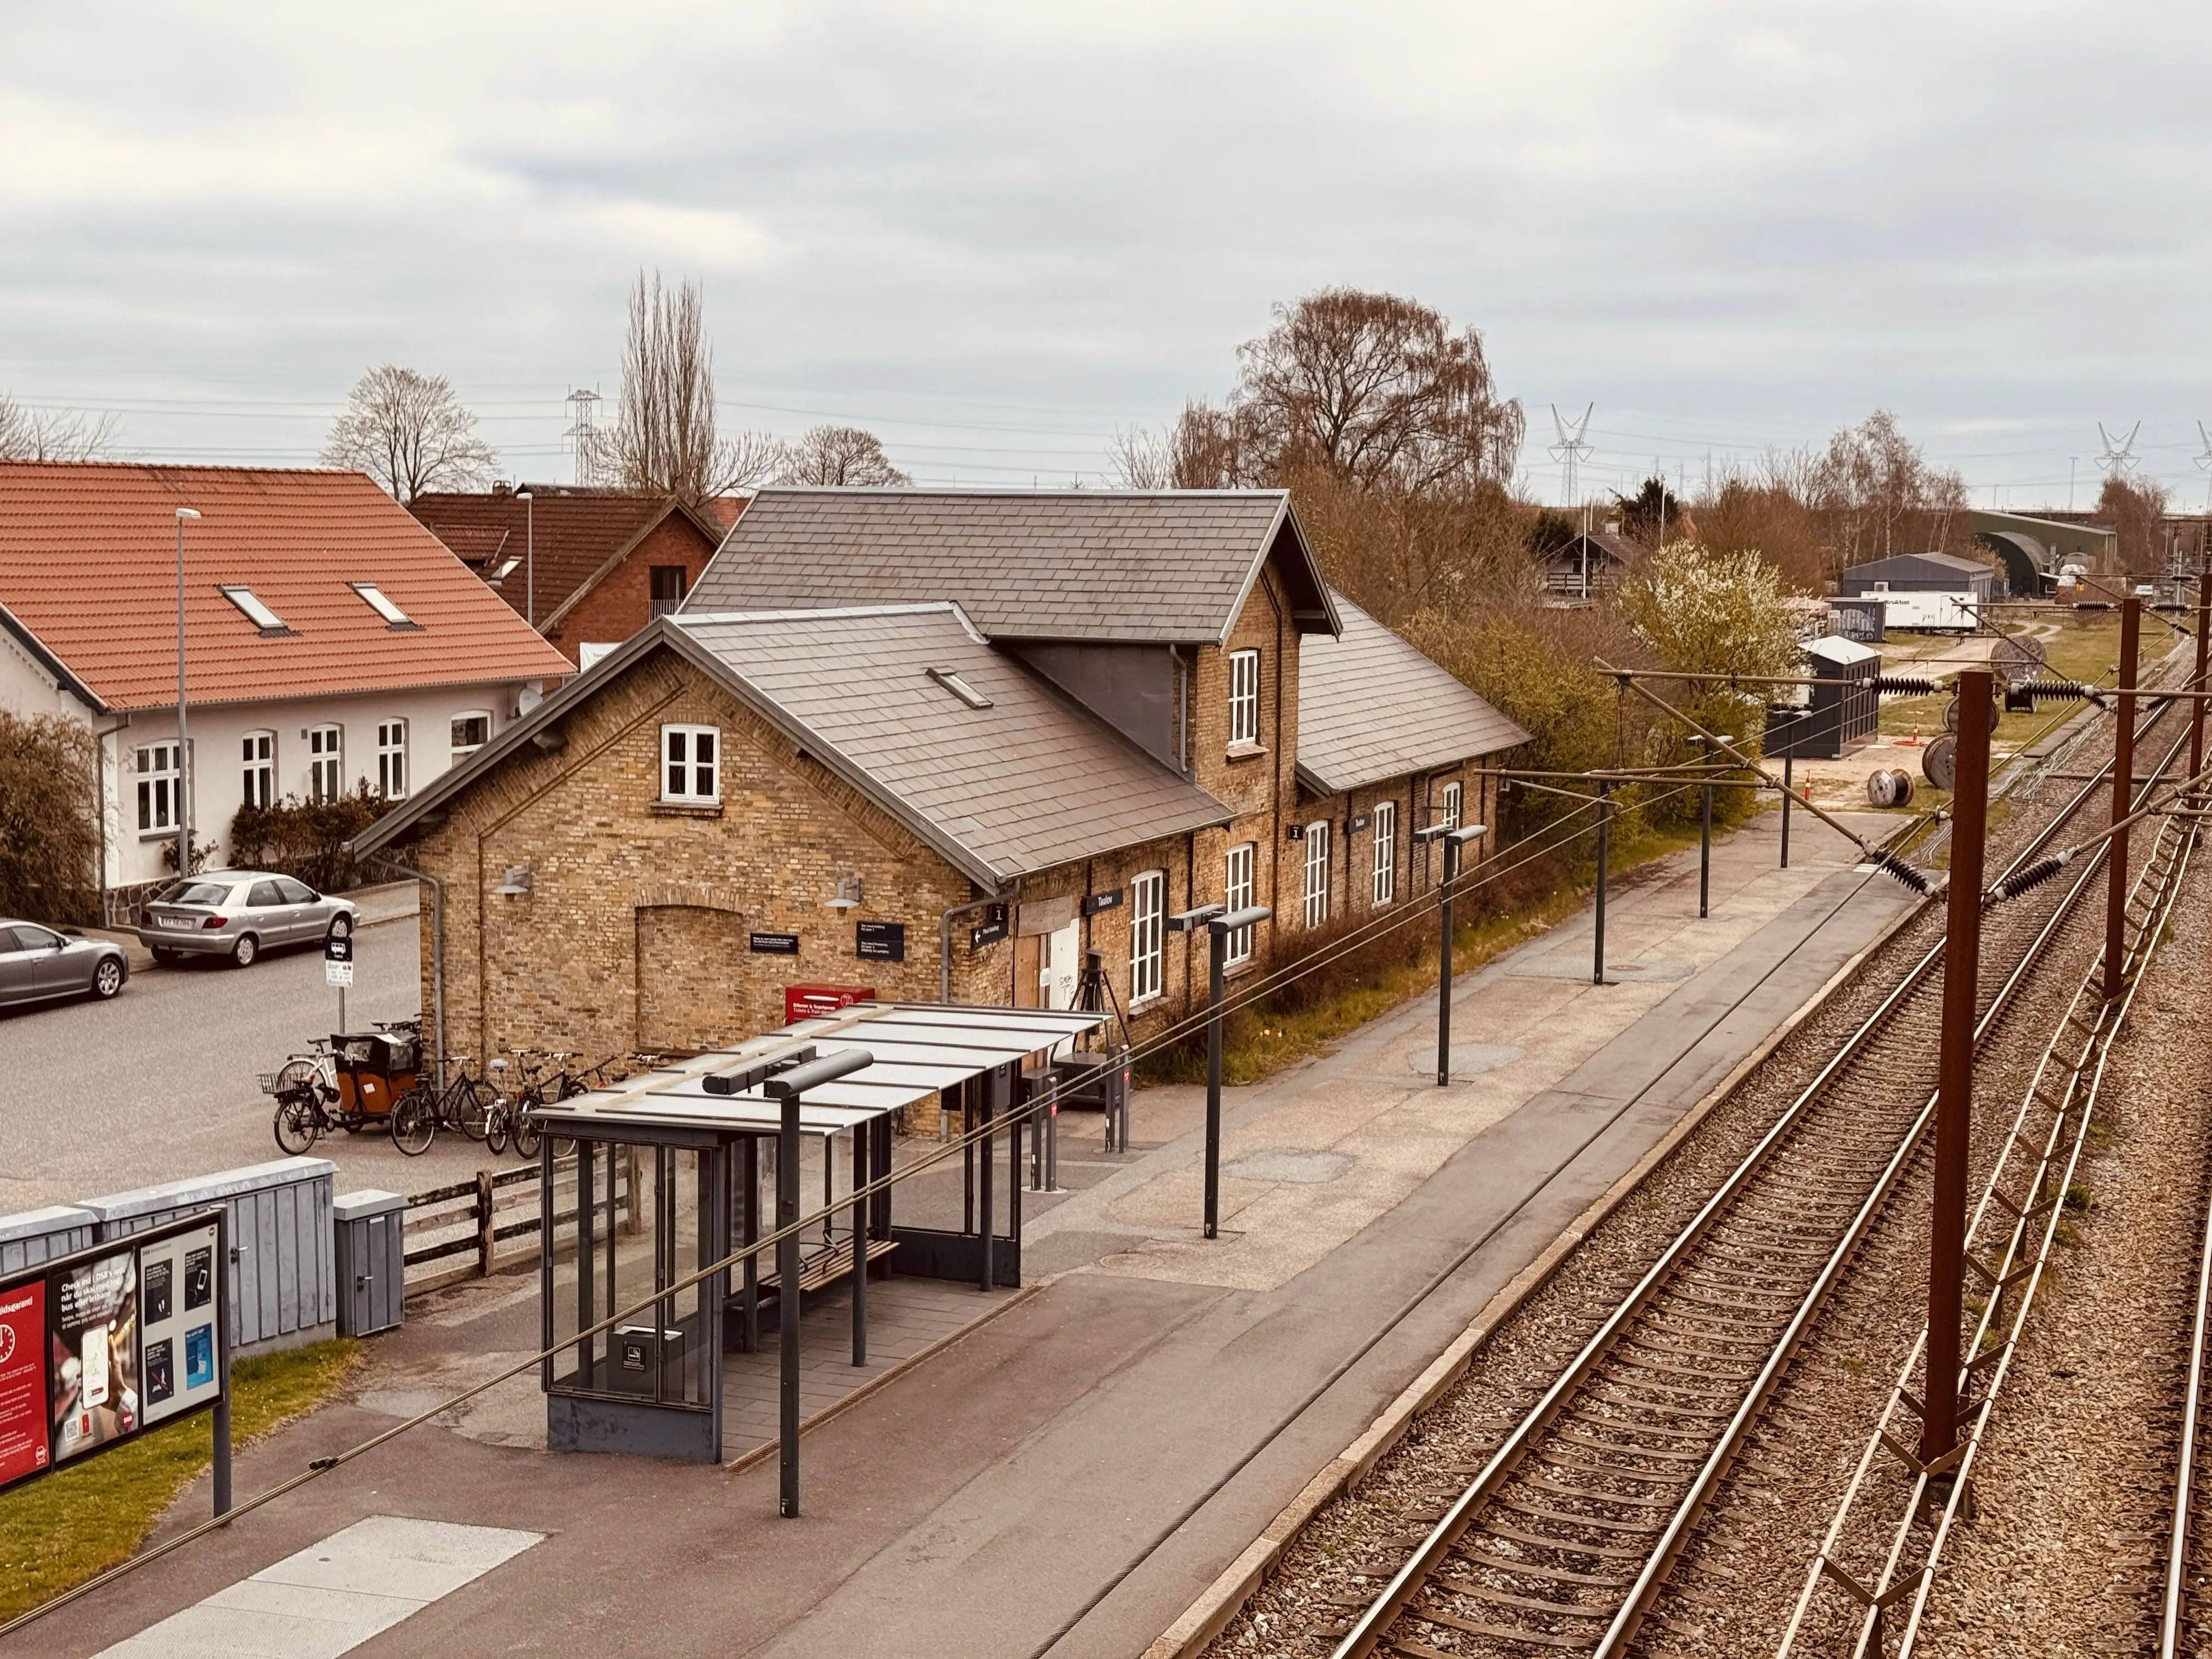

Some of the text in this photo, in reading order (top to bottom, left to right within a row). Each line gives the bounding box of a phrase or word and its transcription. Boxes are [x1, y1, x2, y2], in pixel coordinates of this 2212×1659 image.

[1293, 829, 1299, 838] 1
[1098, 894, 1113, 907] Taulov
[996, 910, 1002, 920] 1
[61, 1280, 81, 1293] Check
[82, 1276, 91, 1285] ind
[61, 1292, 72, 1302] når
[74, 1290, 82, 1298] du
[83, 1285, 95, 1295] skal
[96, 1281, 109, 1291] med
[61, 1290, 111, 1313] bus eller letbane
